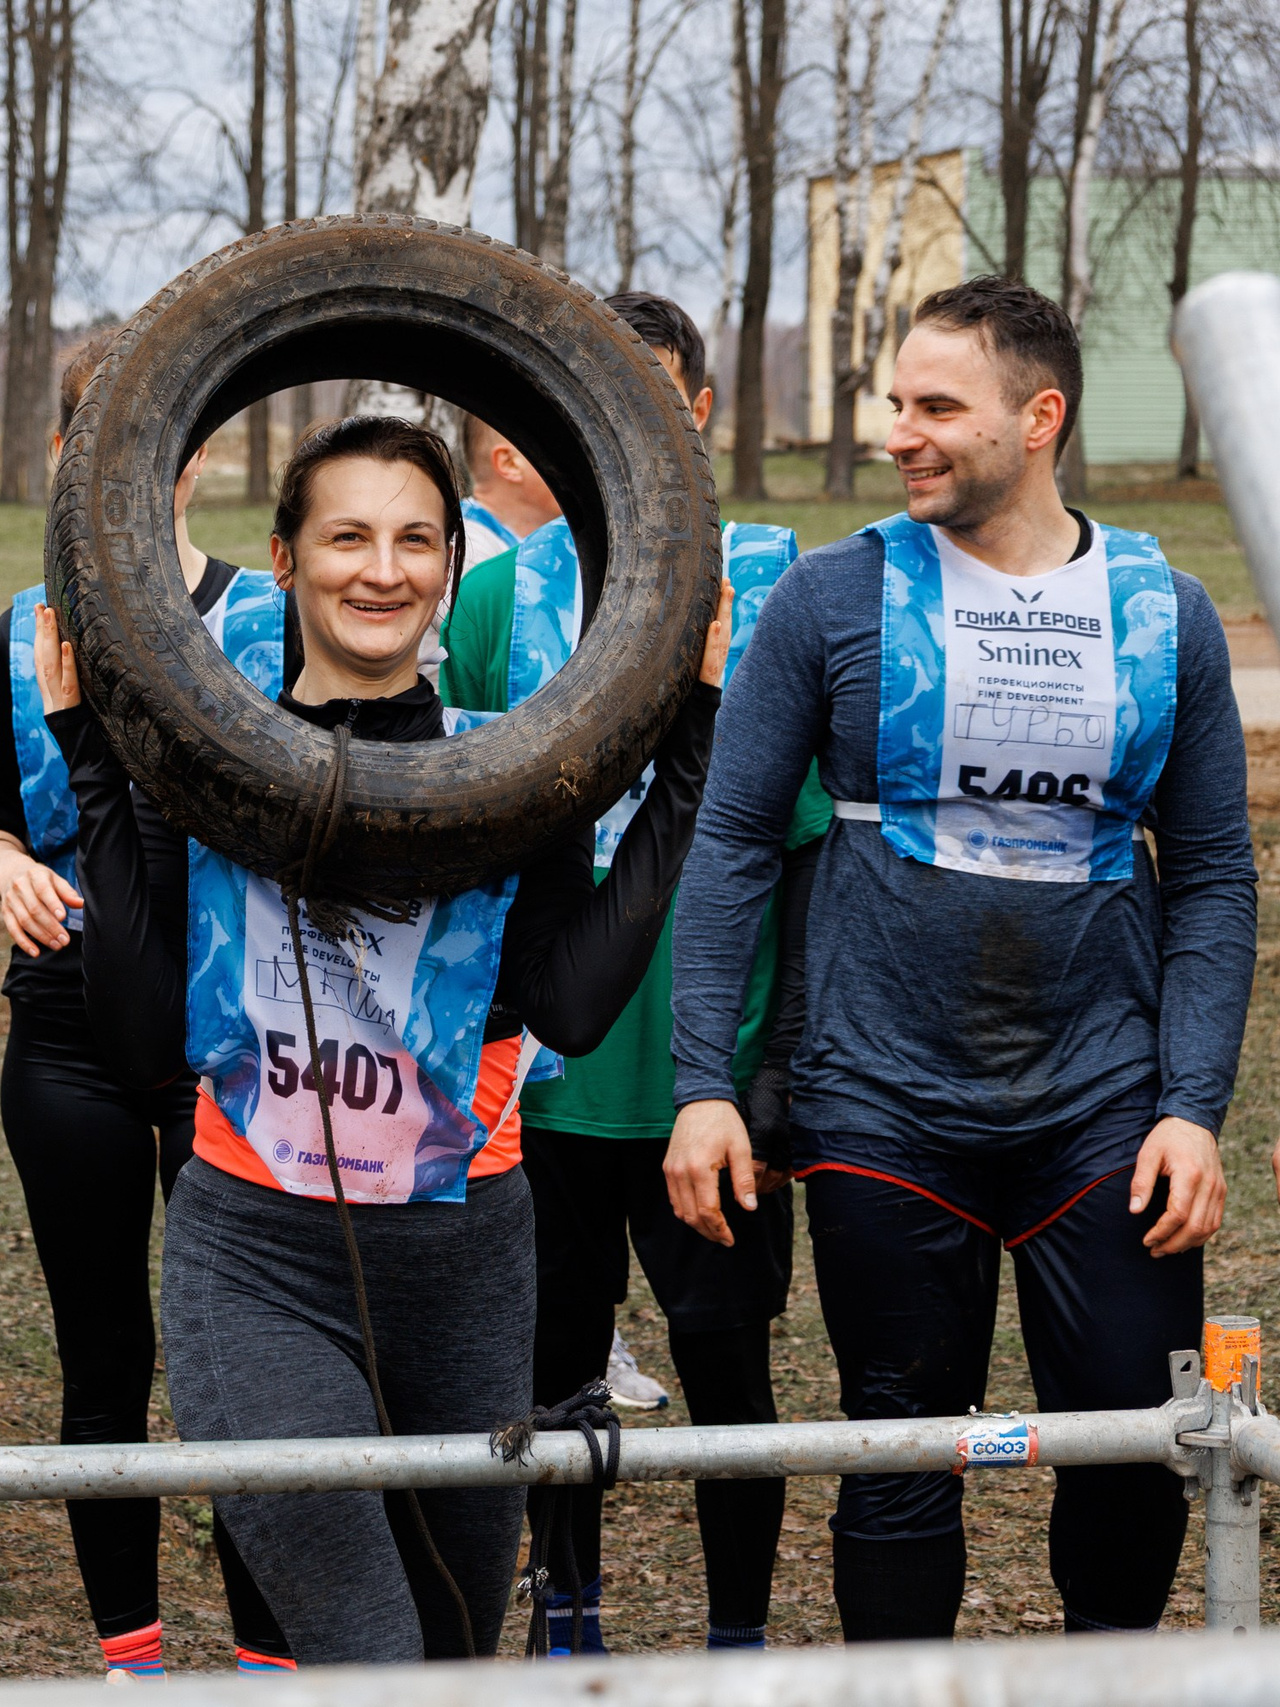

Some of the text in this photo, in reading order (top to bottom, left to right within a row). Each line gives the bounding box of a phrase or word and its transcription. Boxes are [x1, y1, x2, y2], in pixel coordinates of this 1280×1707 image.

[955, 609, 1101, 632] ГОНКА ГЕРОЕВ
[978, 640, 1083, 669] Sminex
[978, 676, 1084, 692] ПЕРФЕКЦИОНИСТЫ
[978, 690, 1084, 706] FINE DEVELOPMENT
[959, 699, 1102, 746] ТУРБО
[991, 836, 1068, 854] ГАЗПРОМБАНК
[282, 942, 308, 955] FIE
[266, 1029, 403, 1115] 5407
[297, 1151, 384, 1174] ГАЗПОМБАНК
[973, 1441, 1026, 1455] СОЮЗ
